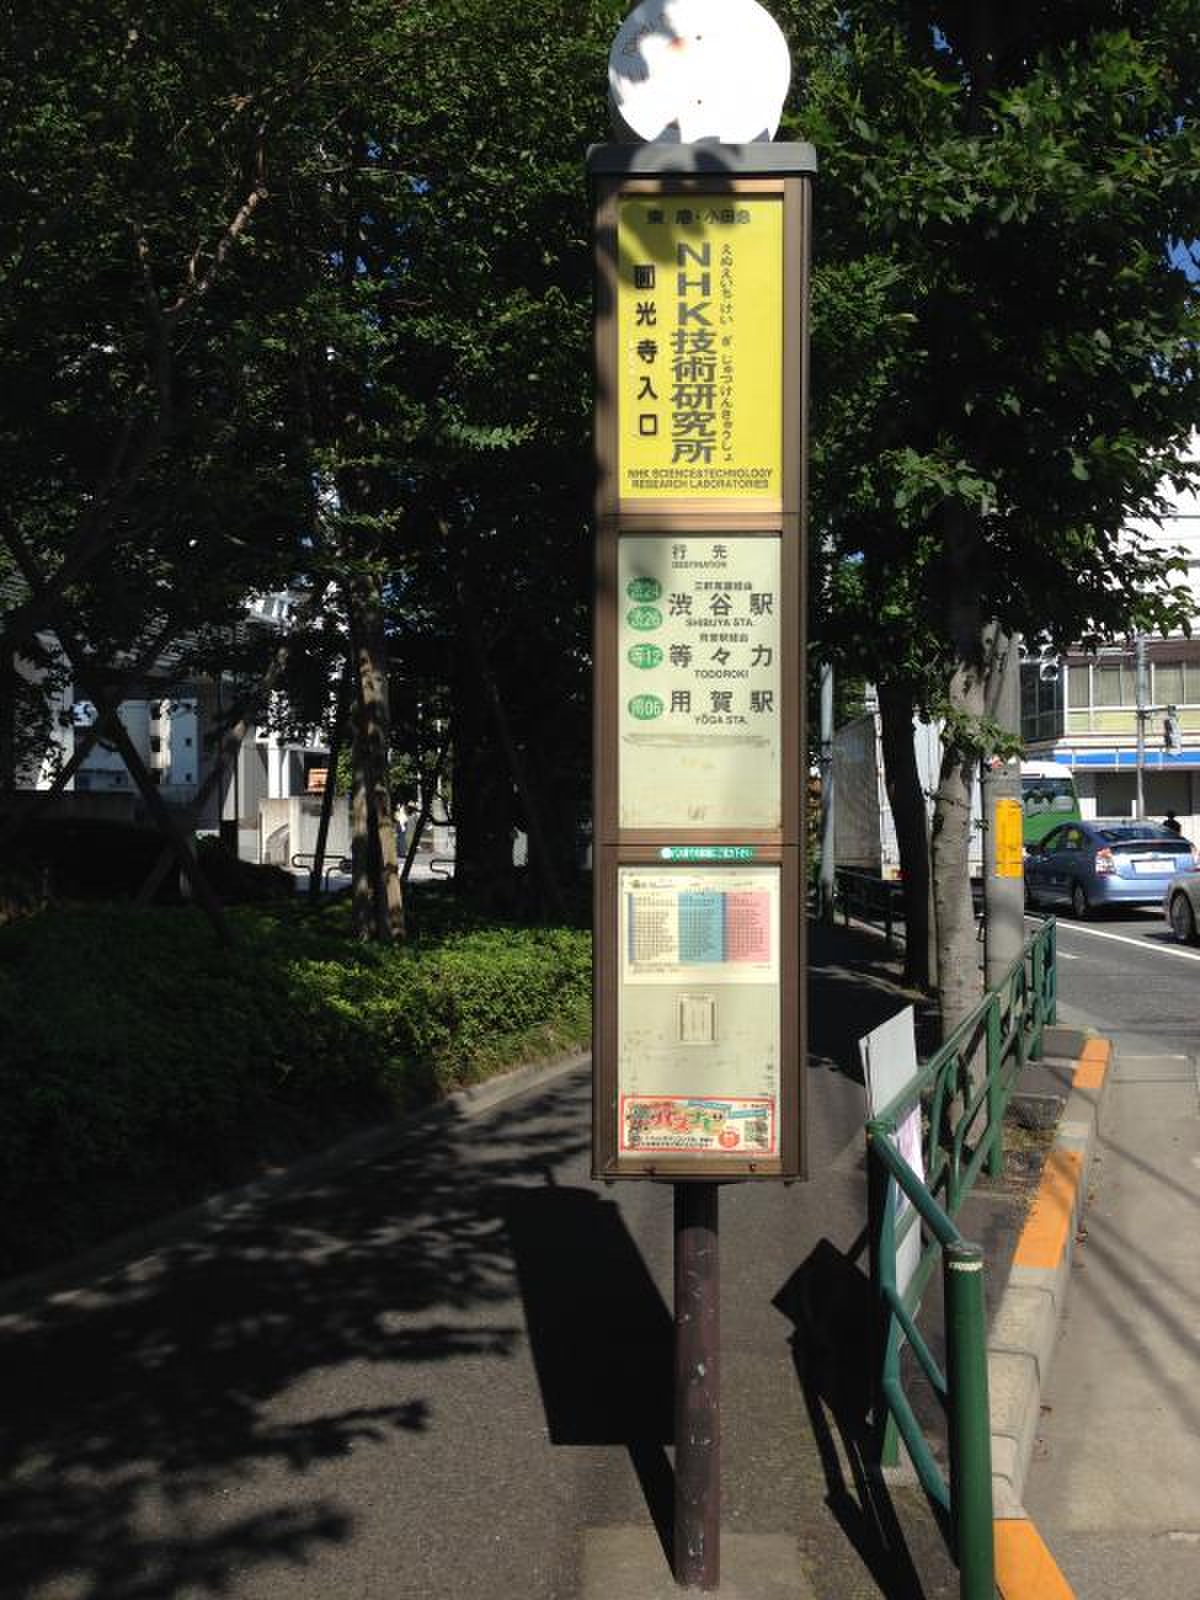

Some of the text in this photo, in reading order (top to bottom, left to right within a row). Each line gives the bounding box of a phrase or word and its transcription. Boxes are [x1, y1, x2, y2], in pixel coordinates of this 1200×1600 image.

[670, 241, 717, 464] NHK技術研究所
[627, 468, 650, 479] NHK
[631, 479, 769, 489] RESEARCH LABORATORIES
[685, 617, 730, 627] SHIBUYA
[669, 643, 773, 668] 等々力
[693, 669, 750, 679] TODOROKI
[670, 689, 774, 713] 用賀駅
